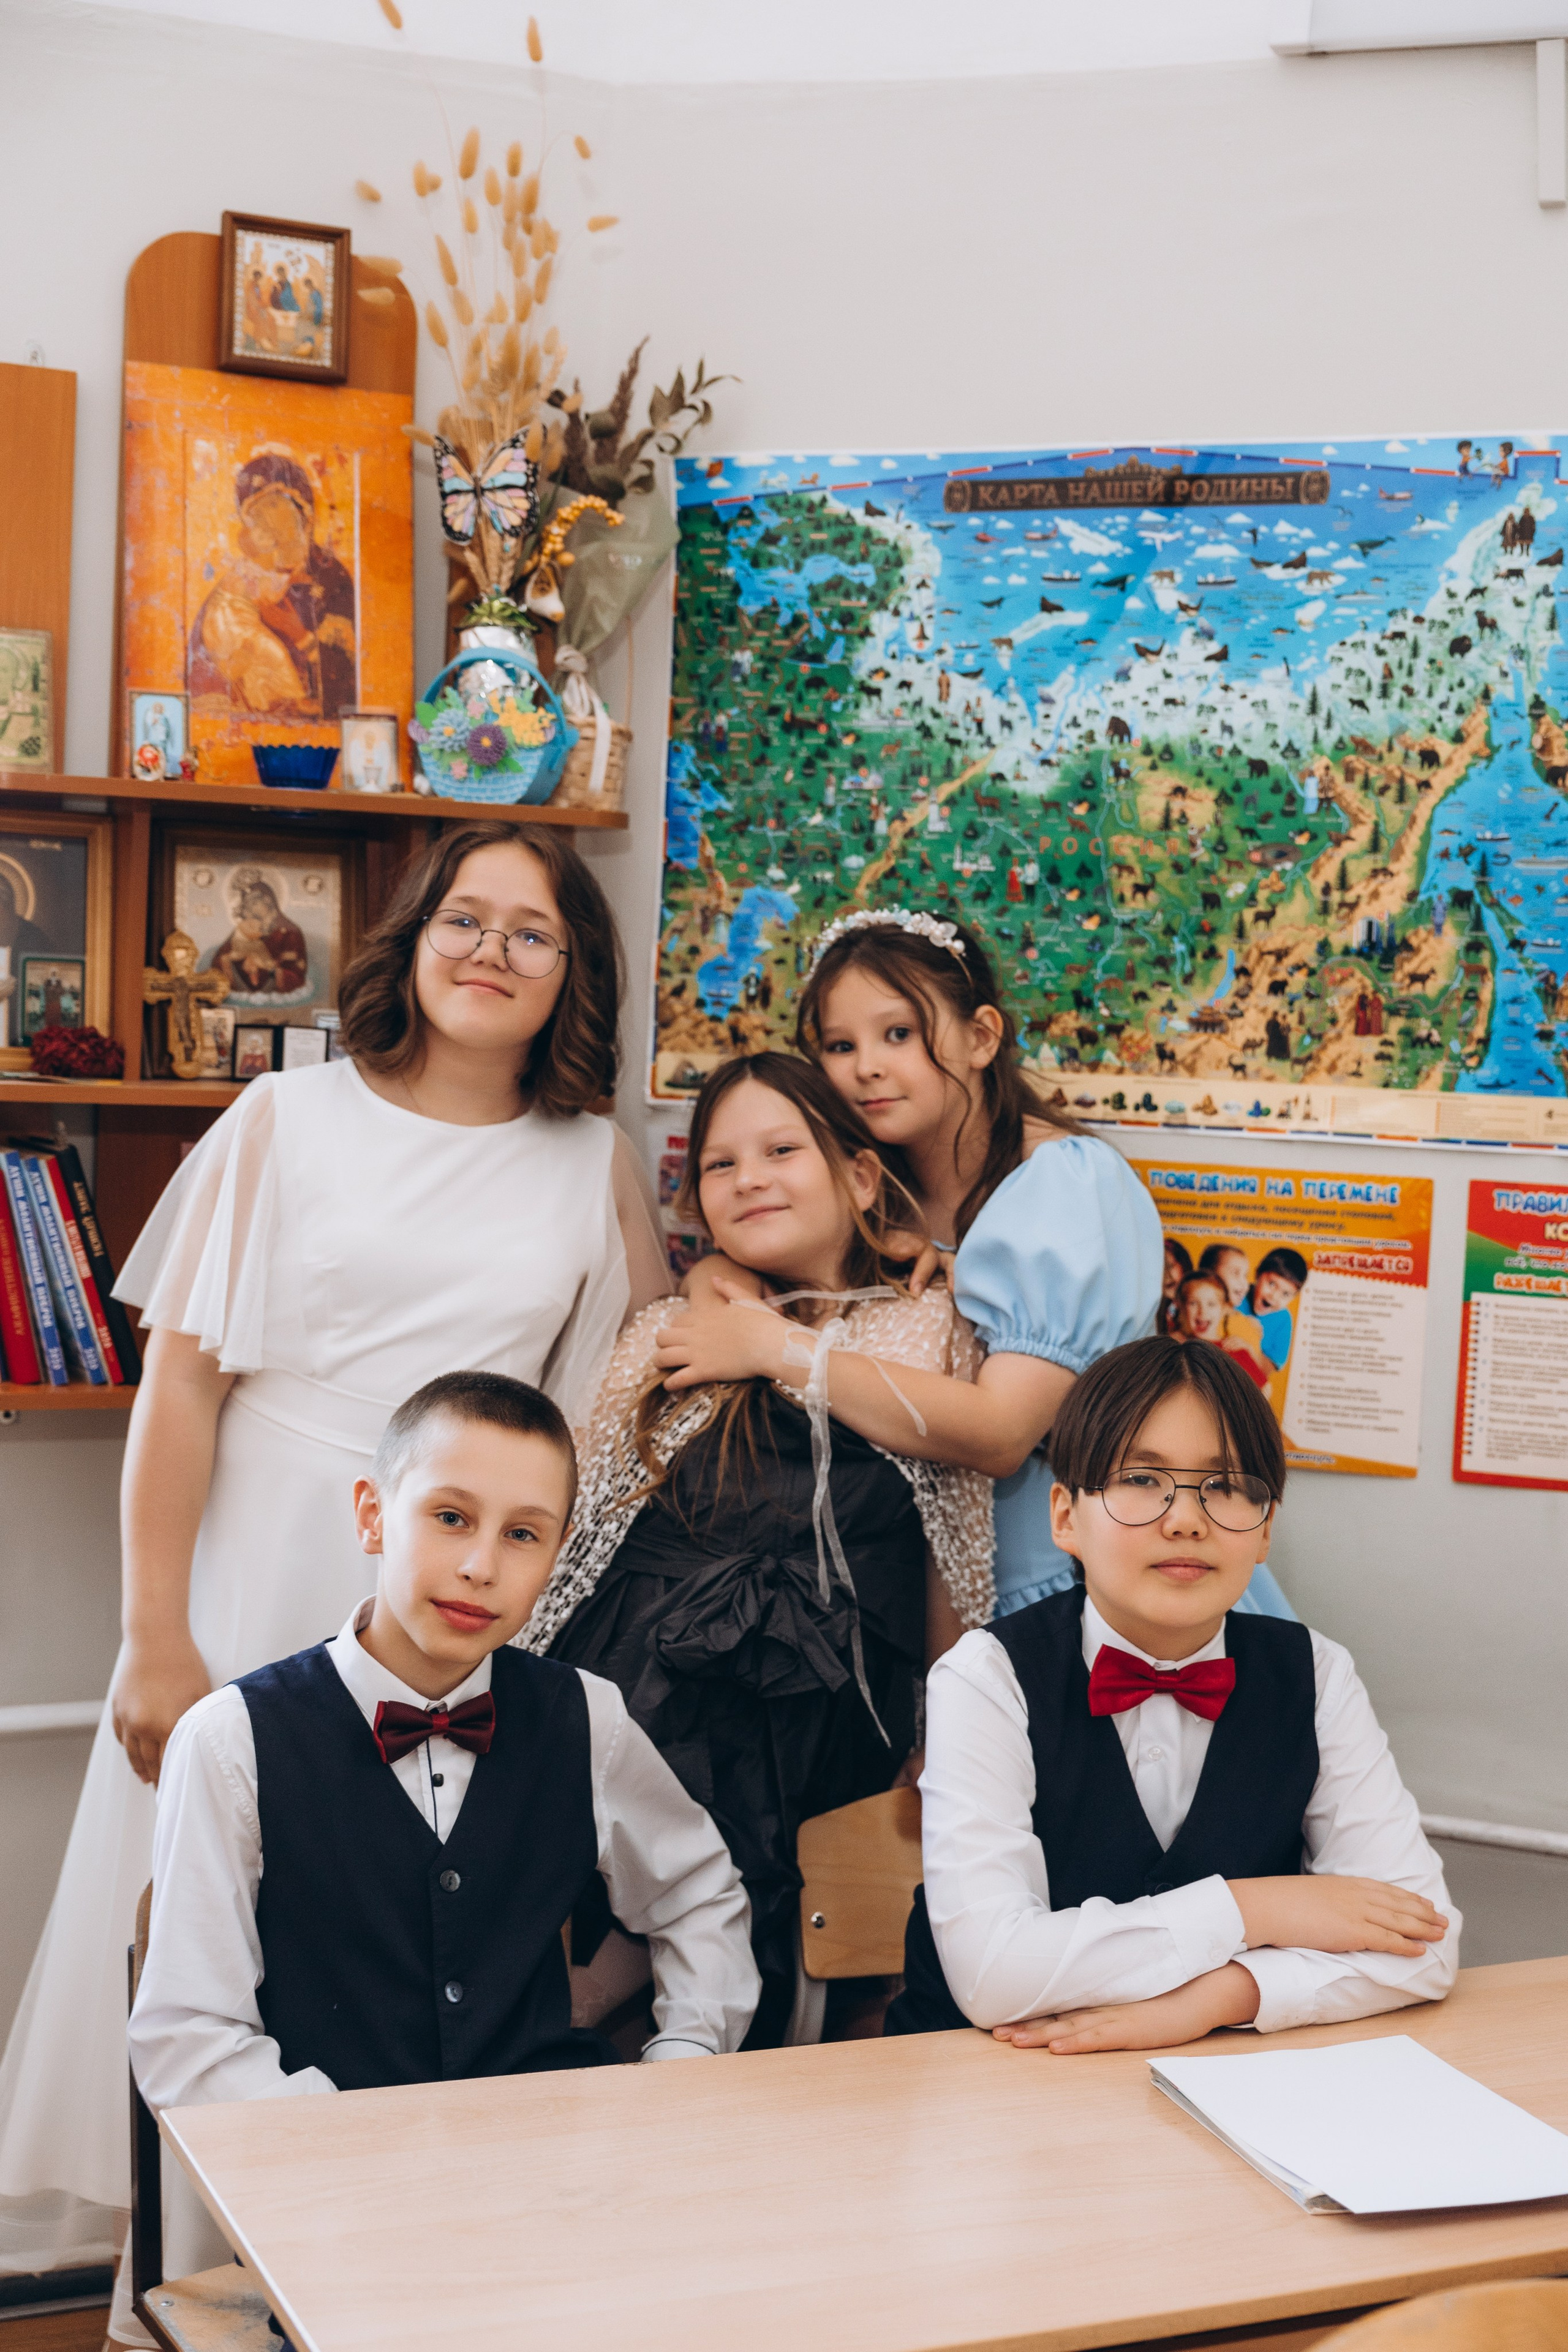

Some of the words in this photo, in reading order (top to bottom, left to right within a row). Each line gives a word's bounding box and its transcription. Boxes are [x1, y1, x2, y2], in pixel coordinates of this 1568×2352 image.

[978, 485, 1057, 507] КАРТА
[1067, 477, 1165, 503] НАШЕЙ
[1174, 478, 1294, 502] РОДИНЫ
[1039, 836, 1178, 856] РОССИЯ
[1150, 1170, 1257, 1194] ПОВЕДЕНИЯ
[1265, 1178, 1293, 1196] НА
[1303, 1180, 1398, 1204] ПЕРЕМЕНЕ
[1316, 1254, 1410, 1271] ЗАПРЕЩАЕТСЯ
